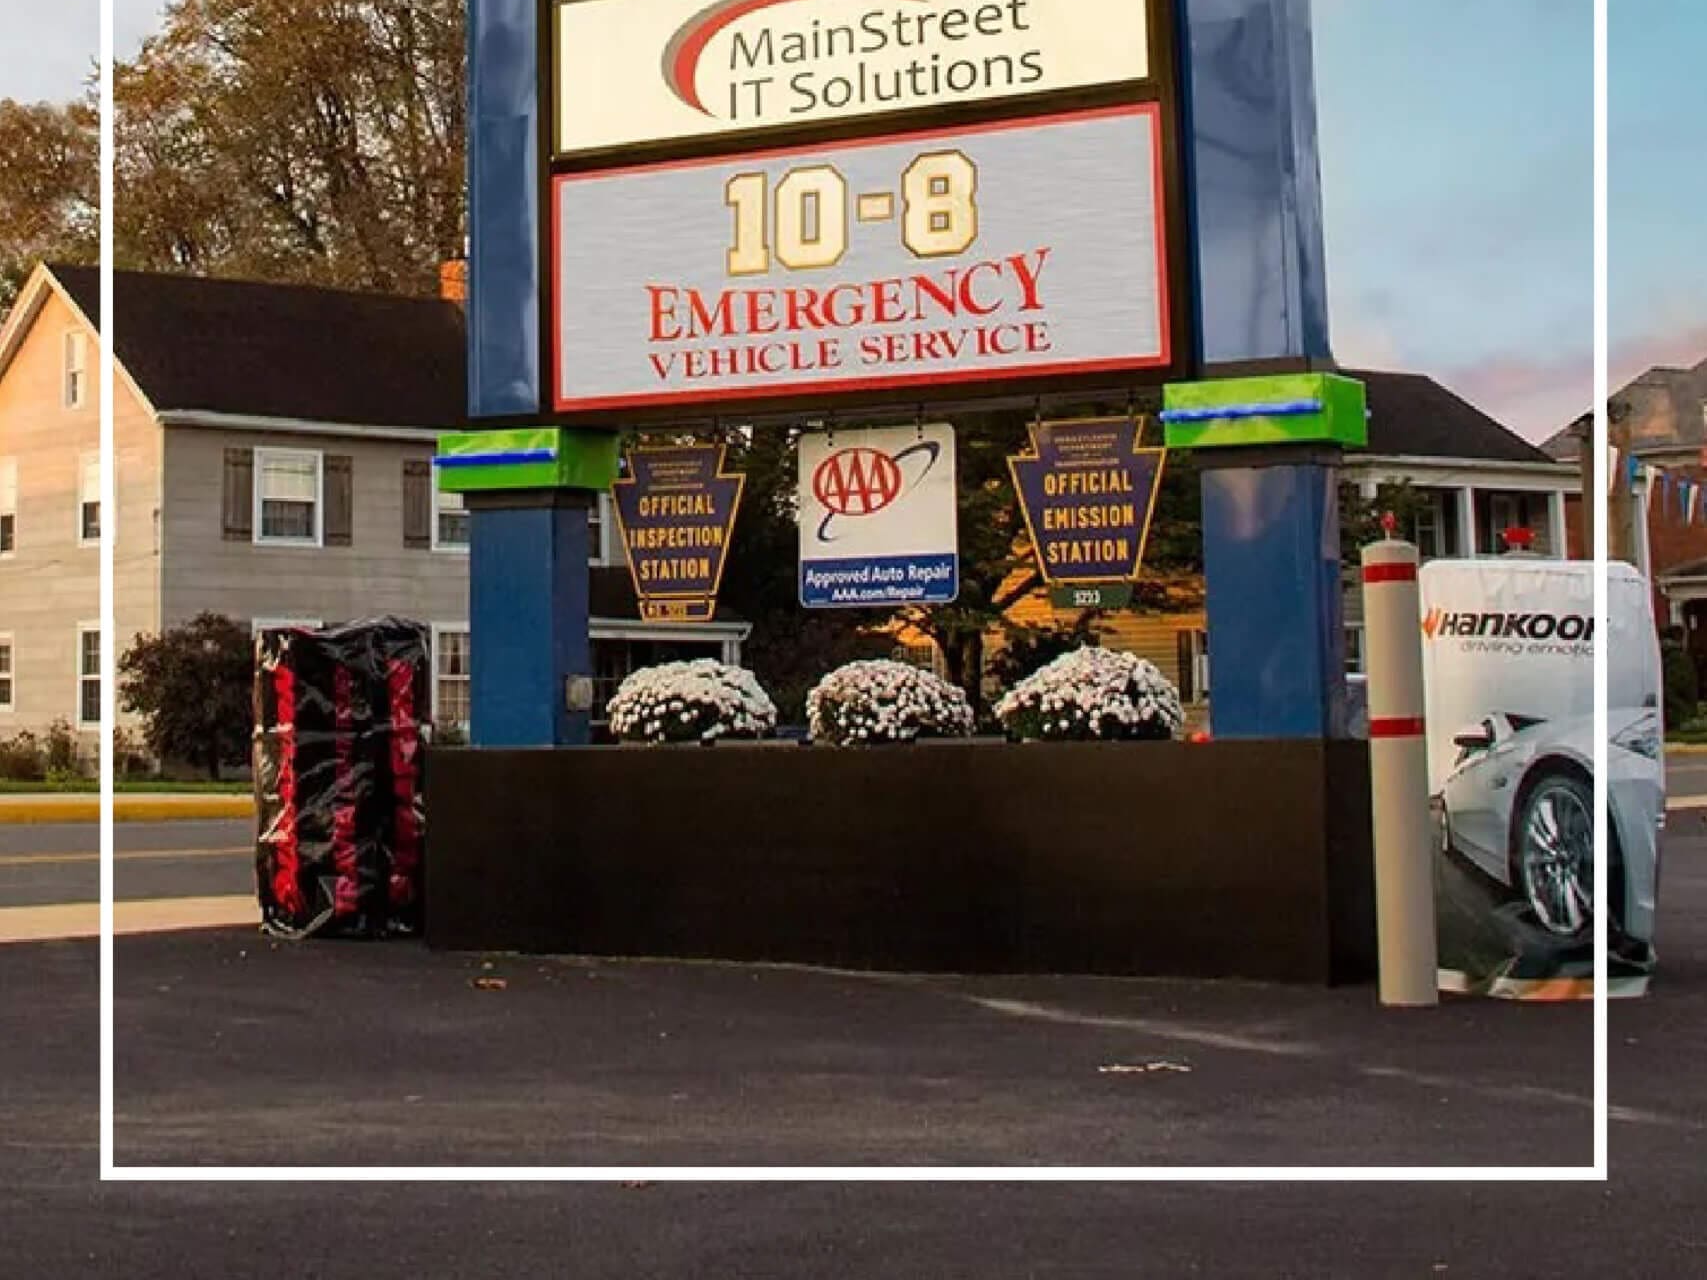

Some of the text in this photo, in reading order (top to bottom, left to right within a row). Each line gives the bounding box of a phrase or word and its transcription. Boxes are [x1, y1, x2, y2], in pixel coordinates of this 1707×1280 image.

[729, 48, 1044, 119] IT Solutions
[725, 148, 979, 276] 10-8
[643, 248, 1051, 342] EMERGENCY
[649, 322, 1051, 379] VEHICLE SERVICE
[818, 448, 898, 515] AAA
[1044, 470, 1133, 495] OFFICIAL
[639, 493, 716, 517] OFFICIAL
[1043, 503, 1135, 530] EMISSION
[630, 526, 723, 549] INSPECTION
[1048, 537, 1129, 564] STATION
[639, 556, 711, 581] STATION
[805, 562, 953, 589] Approved Auto Repair
